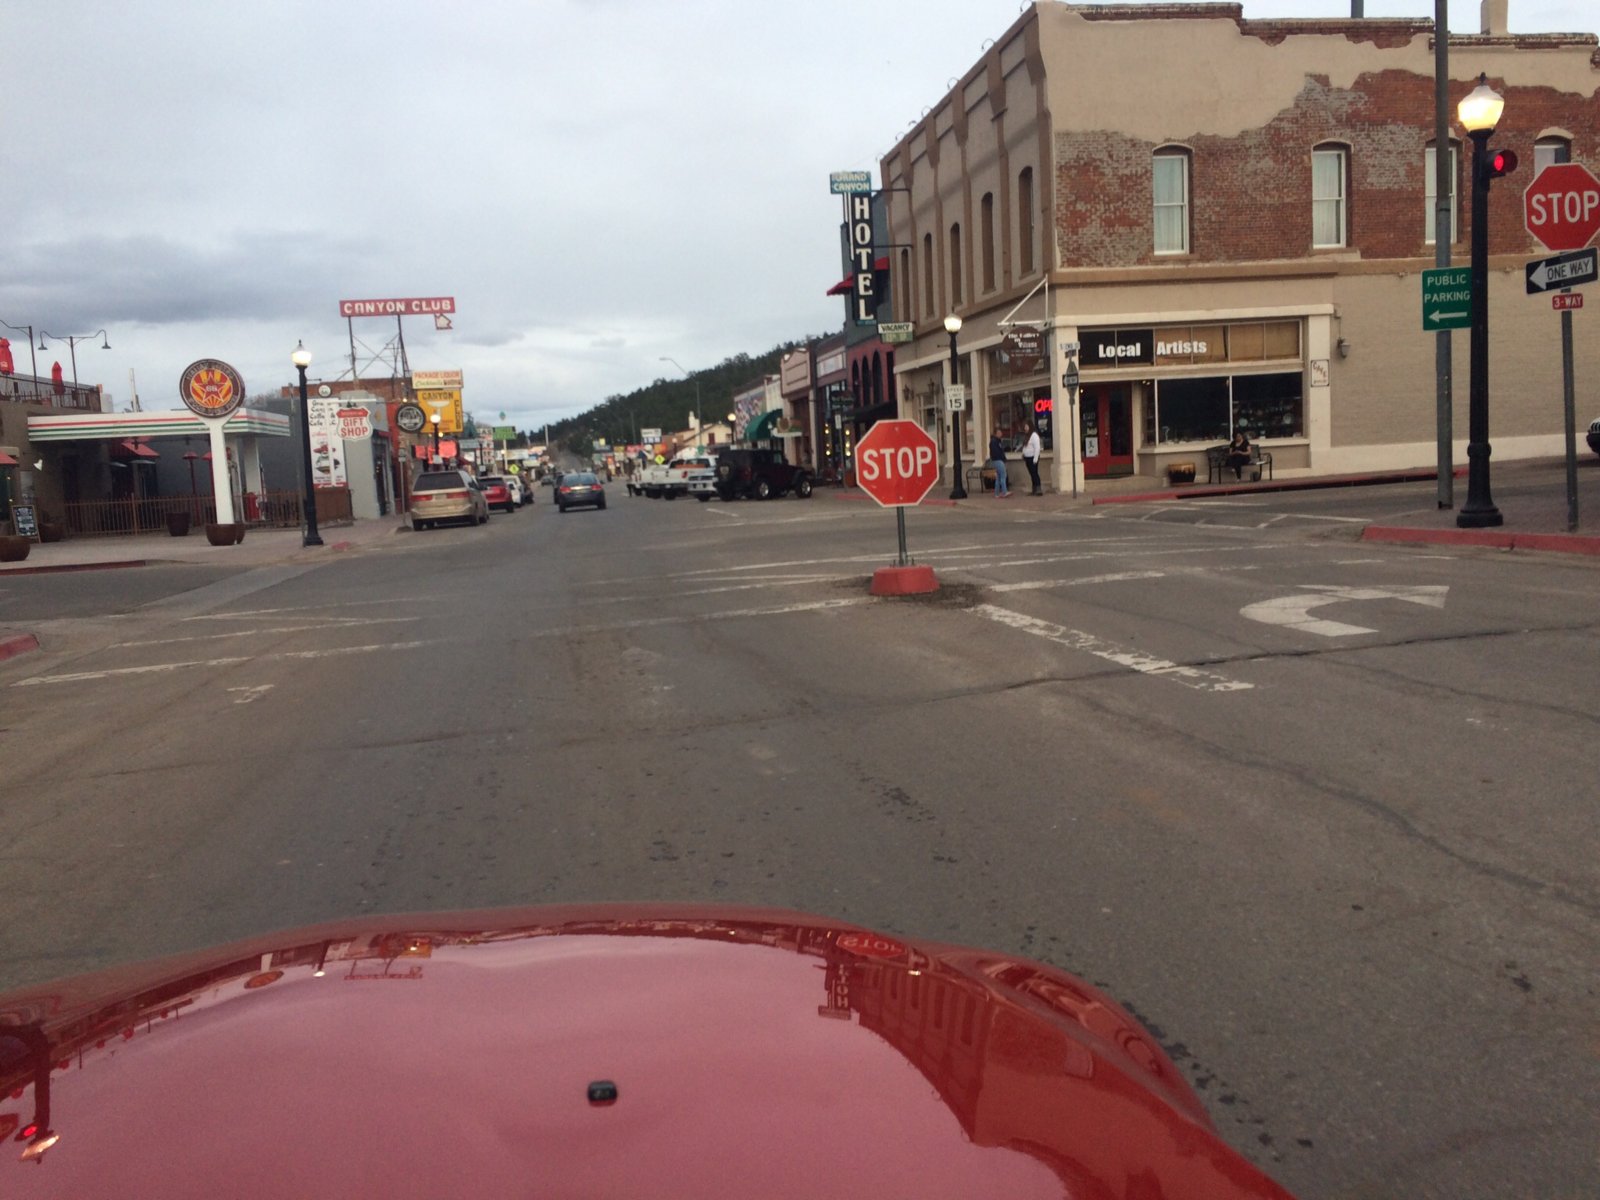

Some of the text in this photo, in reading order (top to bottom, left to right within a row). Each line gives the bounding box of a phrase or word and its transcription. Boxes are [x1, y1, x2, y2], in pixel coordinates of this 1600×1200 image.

[836, 173, 867, 181] GRAND
[833, 182, 870, 191] CANYON
[1531, 190, 1600, 225] STOP
[854, 197, 874, 320] HOTEL
[1547, 260, 1590, 280] ONE WAY
[1427, 273, 1467, 287] PUBLIC
[1424, 290, 1471, 304] PARKING
[1553, 295, 1582, 308] 3-WAY
[344, 299, 451, 314] CANYON CLUB
[881, 323, 910, 332] VACANCY
[1098, 340, 1207, 358] Local Artists
[422, 391, 454, 400] CANYON
[949, 398, 962, 409] 15
[343, 417, 364, 427] GIFT
[340, 426, 368, 438] SHOP
[862, 446, 932, 481] STOP
